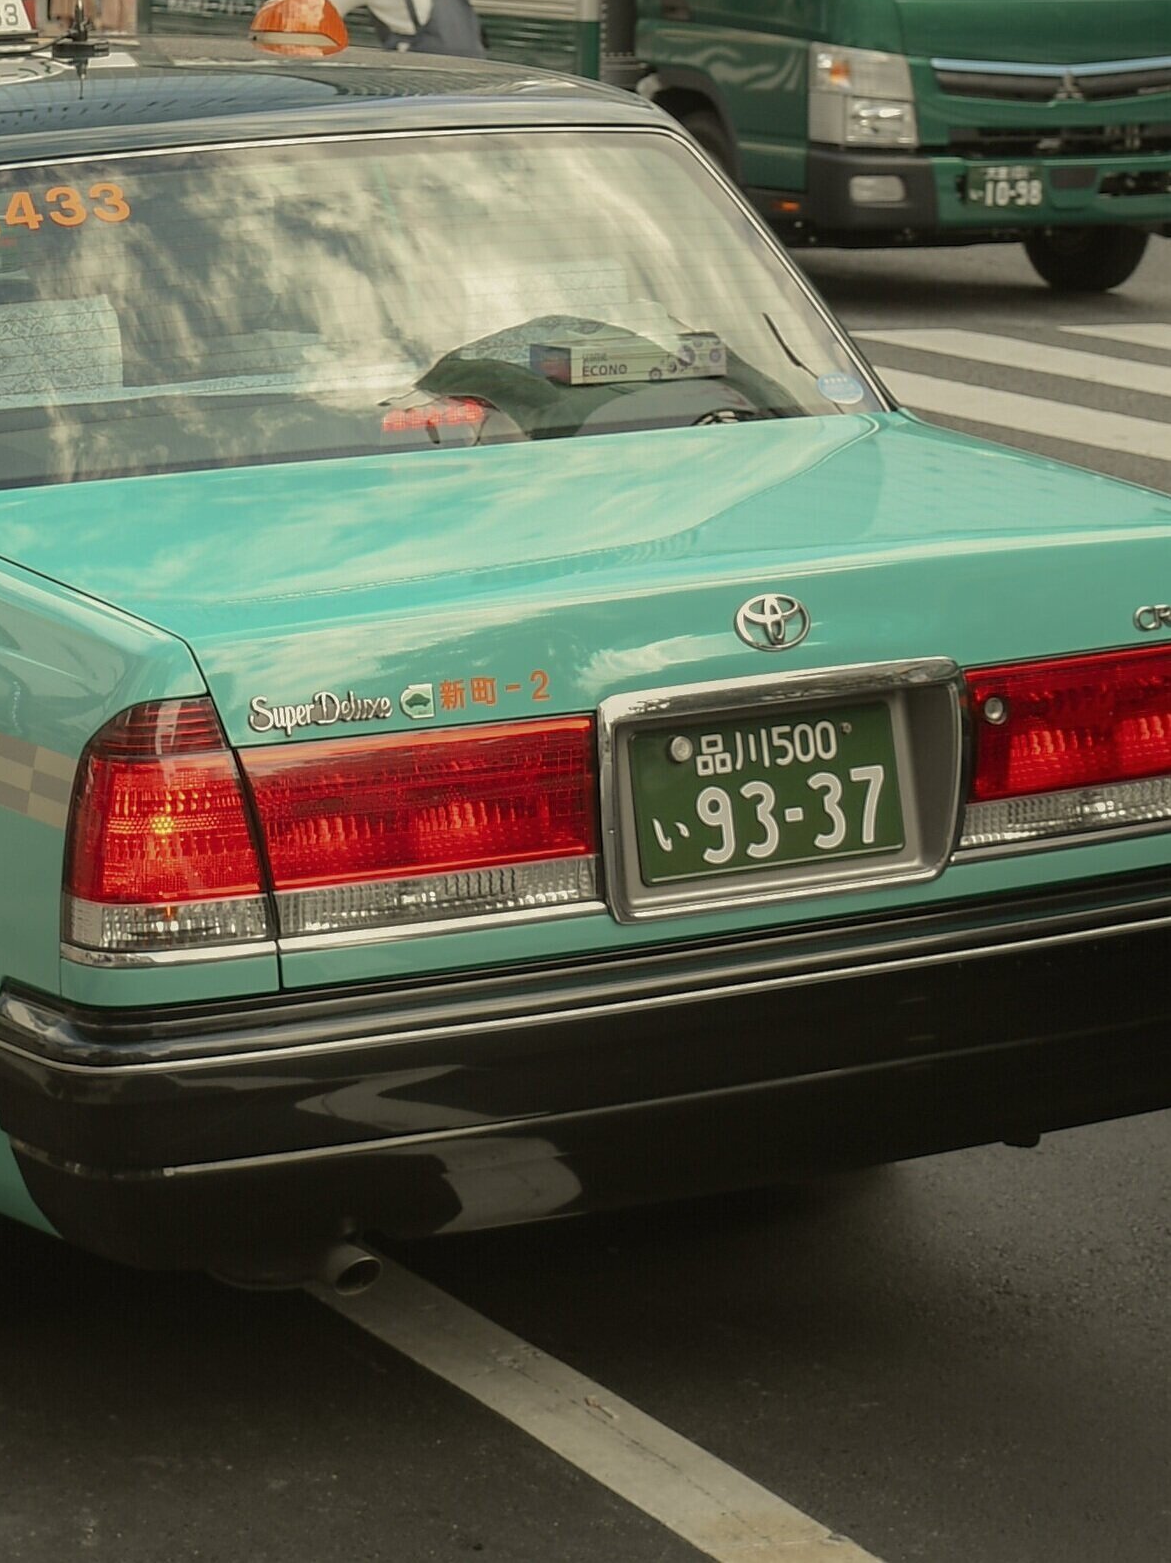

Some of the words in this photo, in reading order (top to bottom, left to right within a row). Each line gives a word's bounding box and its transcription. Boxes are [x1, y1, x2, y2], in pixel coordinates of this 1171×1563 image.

[985, 181, 1043, 207] 10-98
[582, 363, 628, 377] ECONO
[249, 695, 315, 737] Super
[314, 690, 394, 725] Deluxe
[695, 727, 770, 777] 品川
[771, 720, 838, 767] 500
[651, 818, 691, 852] い
[696, 764, 885, 865] 93-37
